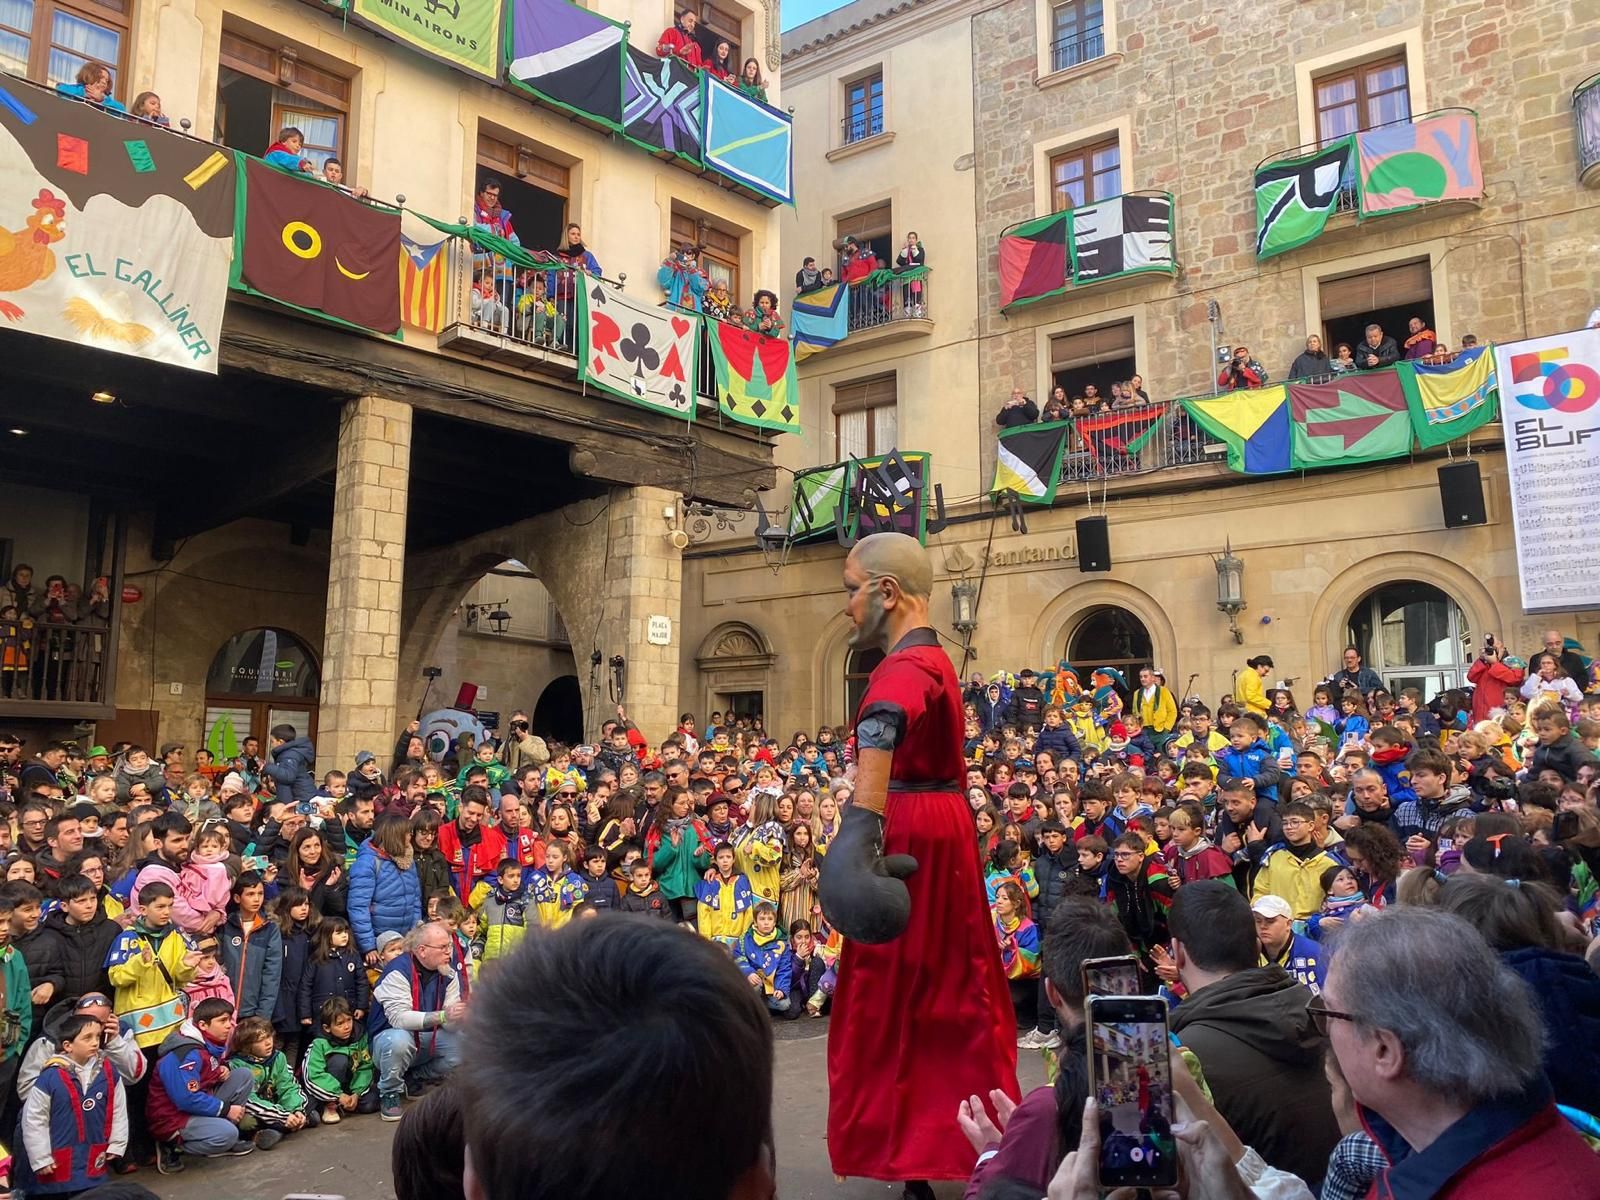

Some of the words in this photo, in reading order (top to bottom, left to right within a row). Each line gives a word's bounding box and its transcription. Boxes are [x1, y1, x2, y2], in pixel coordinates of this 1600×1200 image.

[381, 0, 478, 51] MINAIRONS
[65, 253, 107, 278] EL
[1510, 346, 1600, 413] 50
[1515, 418, 1564, 436] EL
